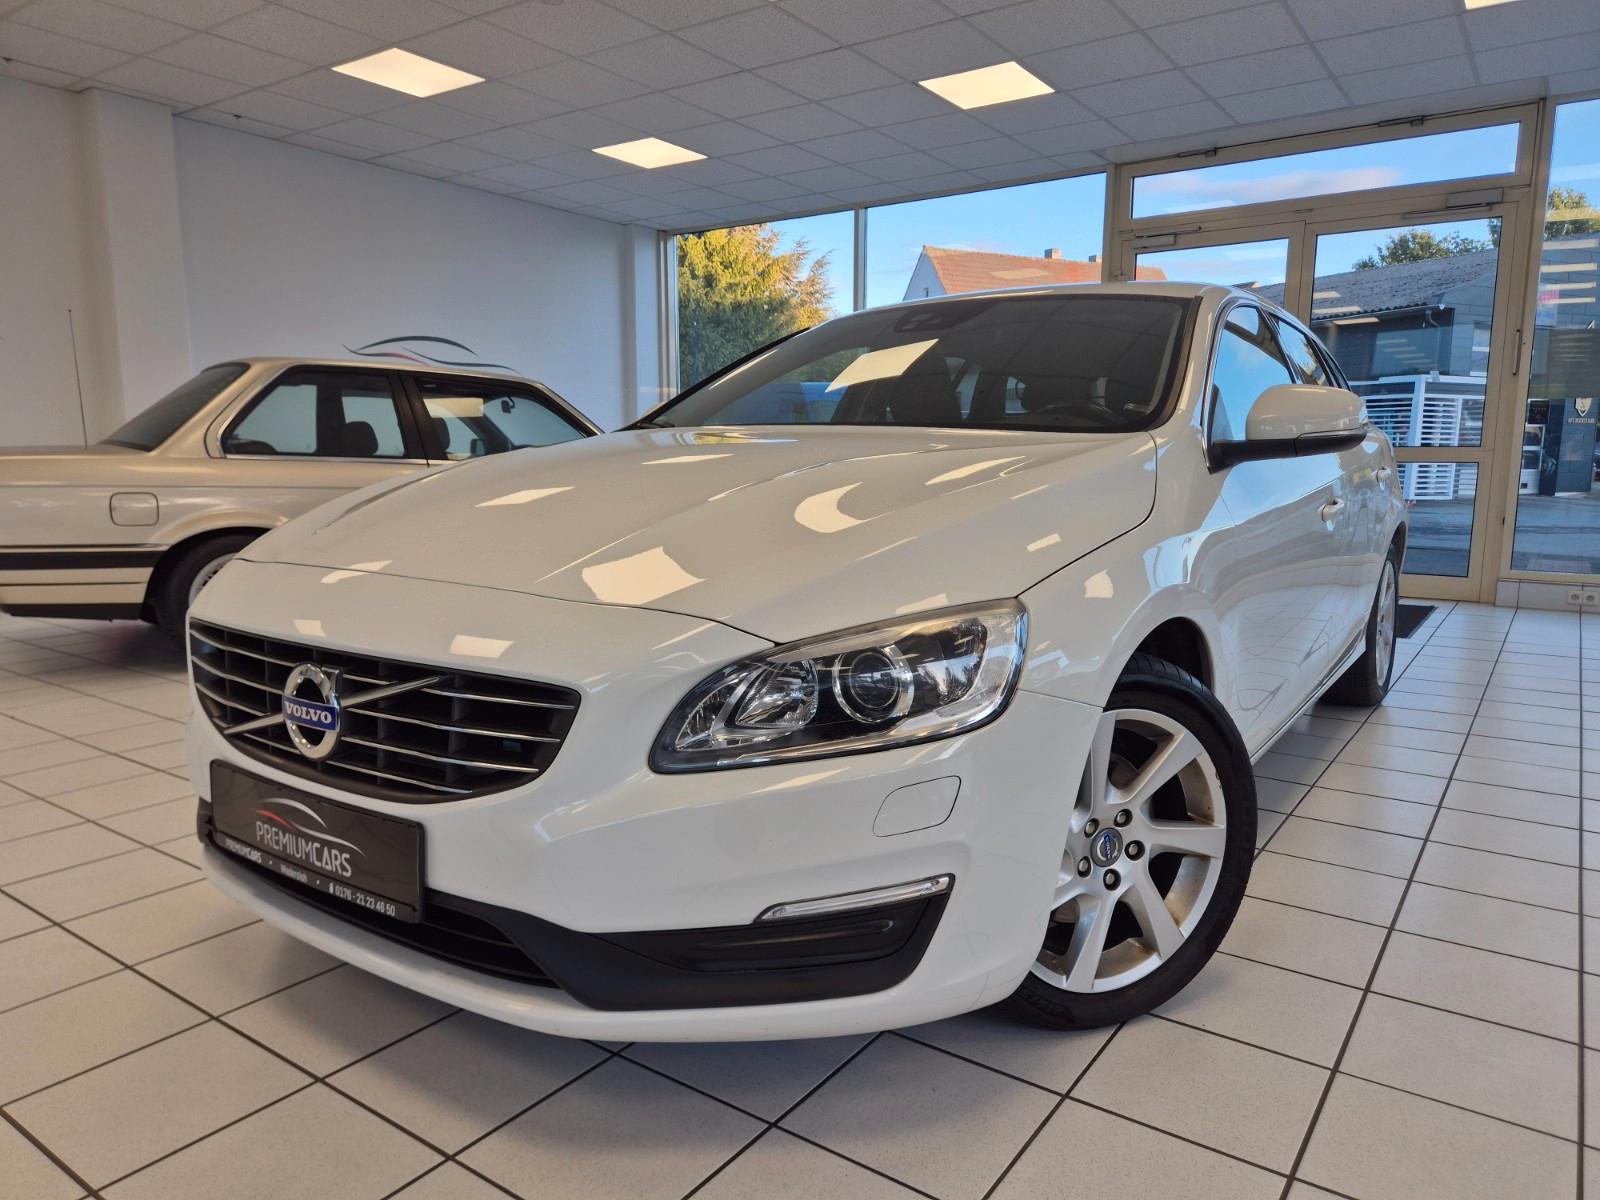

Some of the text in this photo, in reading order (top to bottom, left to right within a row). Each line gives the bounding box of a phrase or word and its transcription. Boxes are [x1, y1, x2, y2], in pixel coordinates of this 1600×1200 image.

[284, 701, 332, 724] VOLVO
[256, 821, 352, 877] PREMIUMCARS
[386, 904, 396, 917] 50
